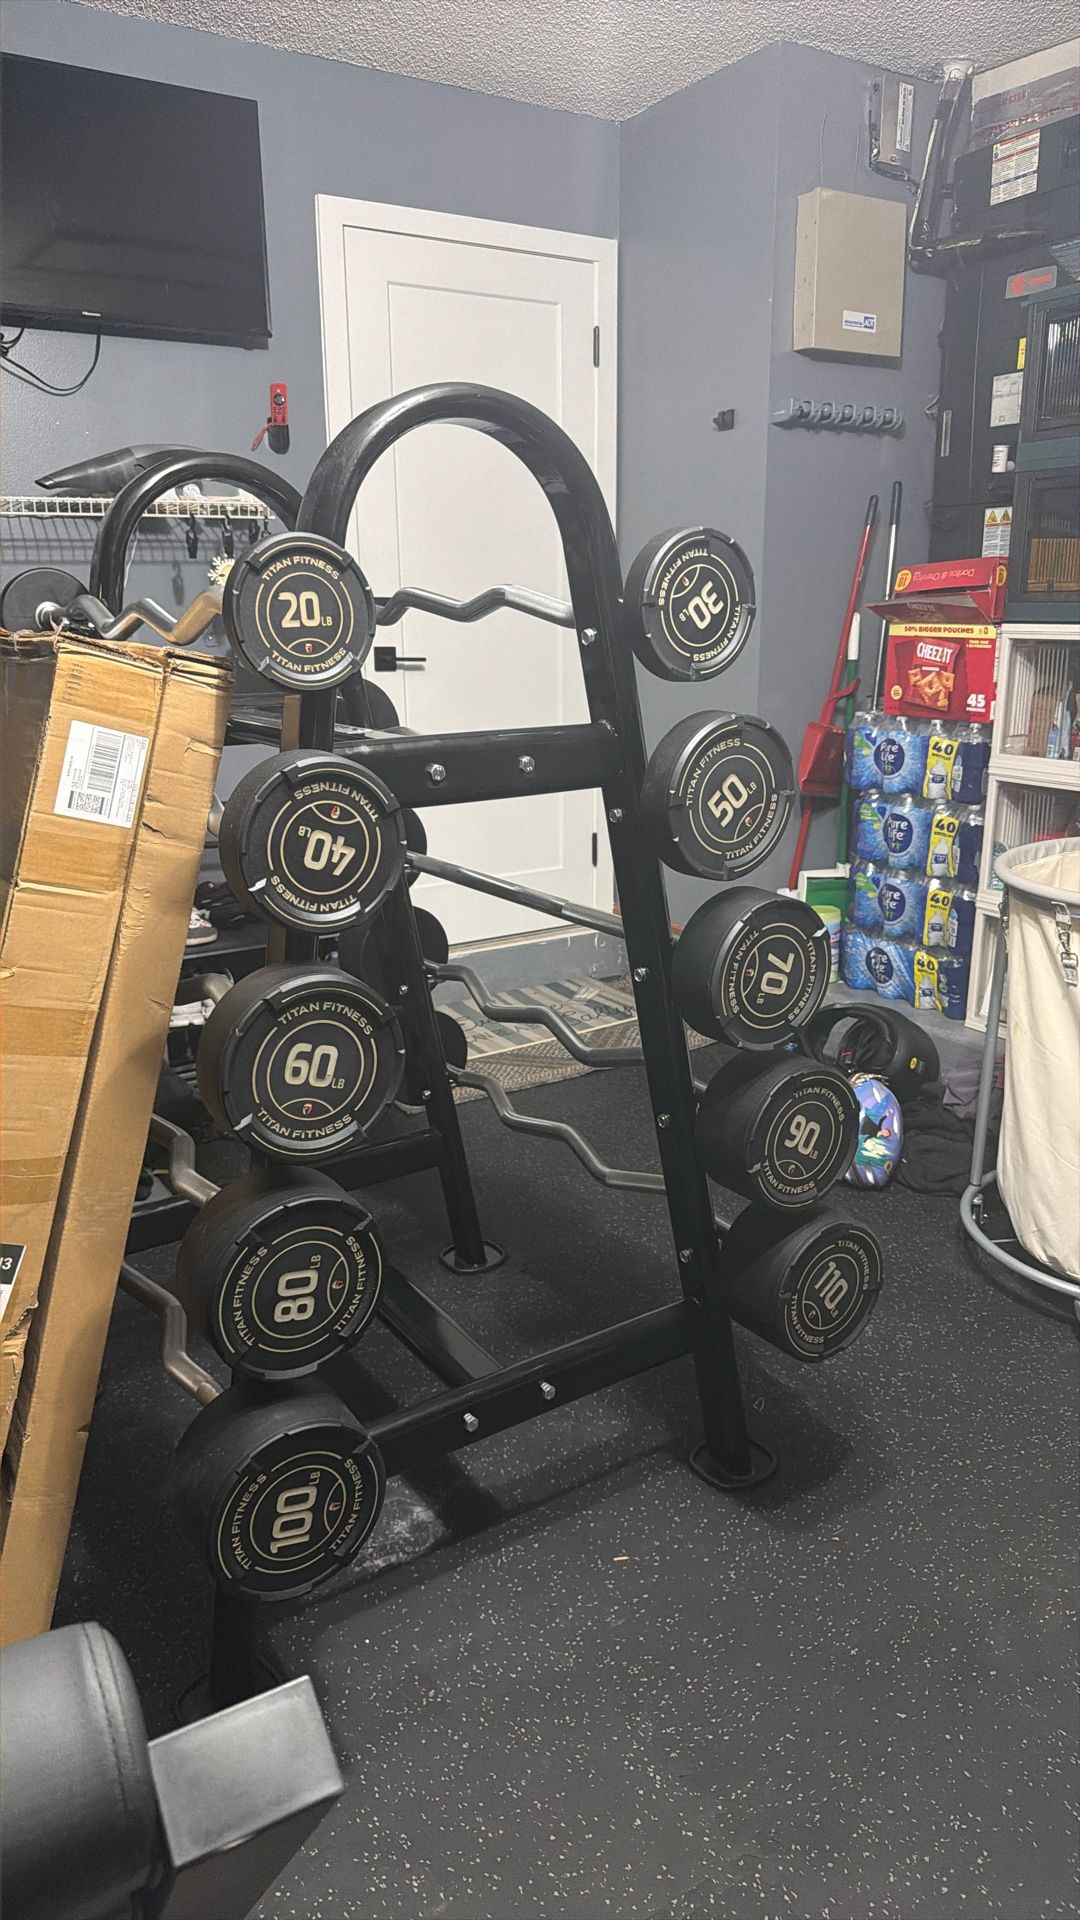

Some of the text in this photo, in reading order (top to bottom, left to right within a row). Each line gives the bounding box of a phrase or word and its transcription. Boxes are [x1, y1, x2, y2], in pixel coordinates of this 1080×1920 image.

[262, 556, 339, 581] TITAN FITNESS
[659, 548, 708, 606] TITAN FITNESS
[948, 568, 975, 577] Doritos
[278, 591, 333, 628] 20 LB
[679, 581, 724, 630] 30 LB
[693, 605, 741, 661] TITAN FITNESS
[272, 648, 346, 672] TITAN FITNESS
[966, 694, 986, 707] 45
[686, 738, 741, 806] TITAN FITNESS
[932, 742, 954, 756] 40
[294, 782, 379, 822] TITAN FITNESS
[707, 773, 758, 828] 50 LB
[888, 816, 909, 830] Pure
[726, 793, 778, 859] TITAN FITNESS
[935, 819, 956, 834] 40
[298, 825, 356, 876] 40 LB
[271, 875, 357, 911] TITAN FITNESS
[930, 893, 950, 906] 40
[728, 931, 759, 1014] TITAN FITNESS
[757, 952, 795, 1004] 70 LB
[788, 939, 816, 1021] TITAN FITNESS
[278, 1002, 374, 1036] TITAN FITNESS
[284, 1042, 346, 1090] 60 LB
[258, 1107, 352, 1138] TITAN FITNESS
[794, 1086, 844, 1122] TITAN FITNESS
[784, 1114, 820, 1160] 90 LB
[762, 1158, 815, 1194] TITAN FITNESS
[274, 1254, 322, 1323] 80 LB
[333, 1236, 366, 1331] TITAN FITNESS
[814, 1261, 848, 1309] 110
[838, 1240, 870, 1290] TITAN FITNESS
[233, 1246, 268, 1347] TITAN FITNESS
[791, 1294, 824, 1344] TITAN FITNESS
[232, 1473, 268, 1570] TITAN FITNESS
[270, 1471, 320, 1554] 100 LB
[329, 1458, 364, 1550] TITAN FITNESS
